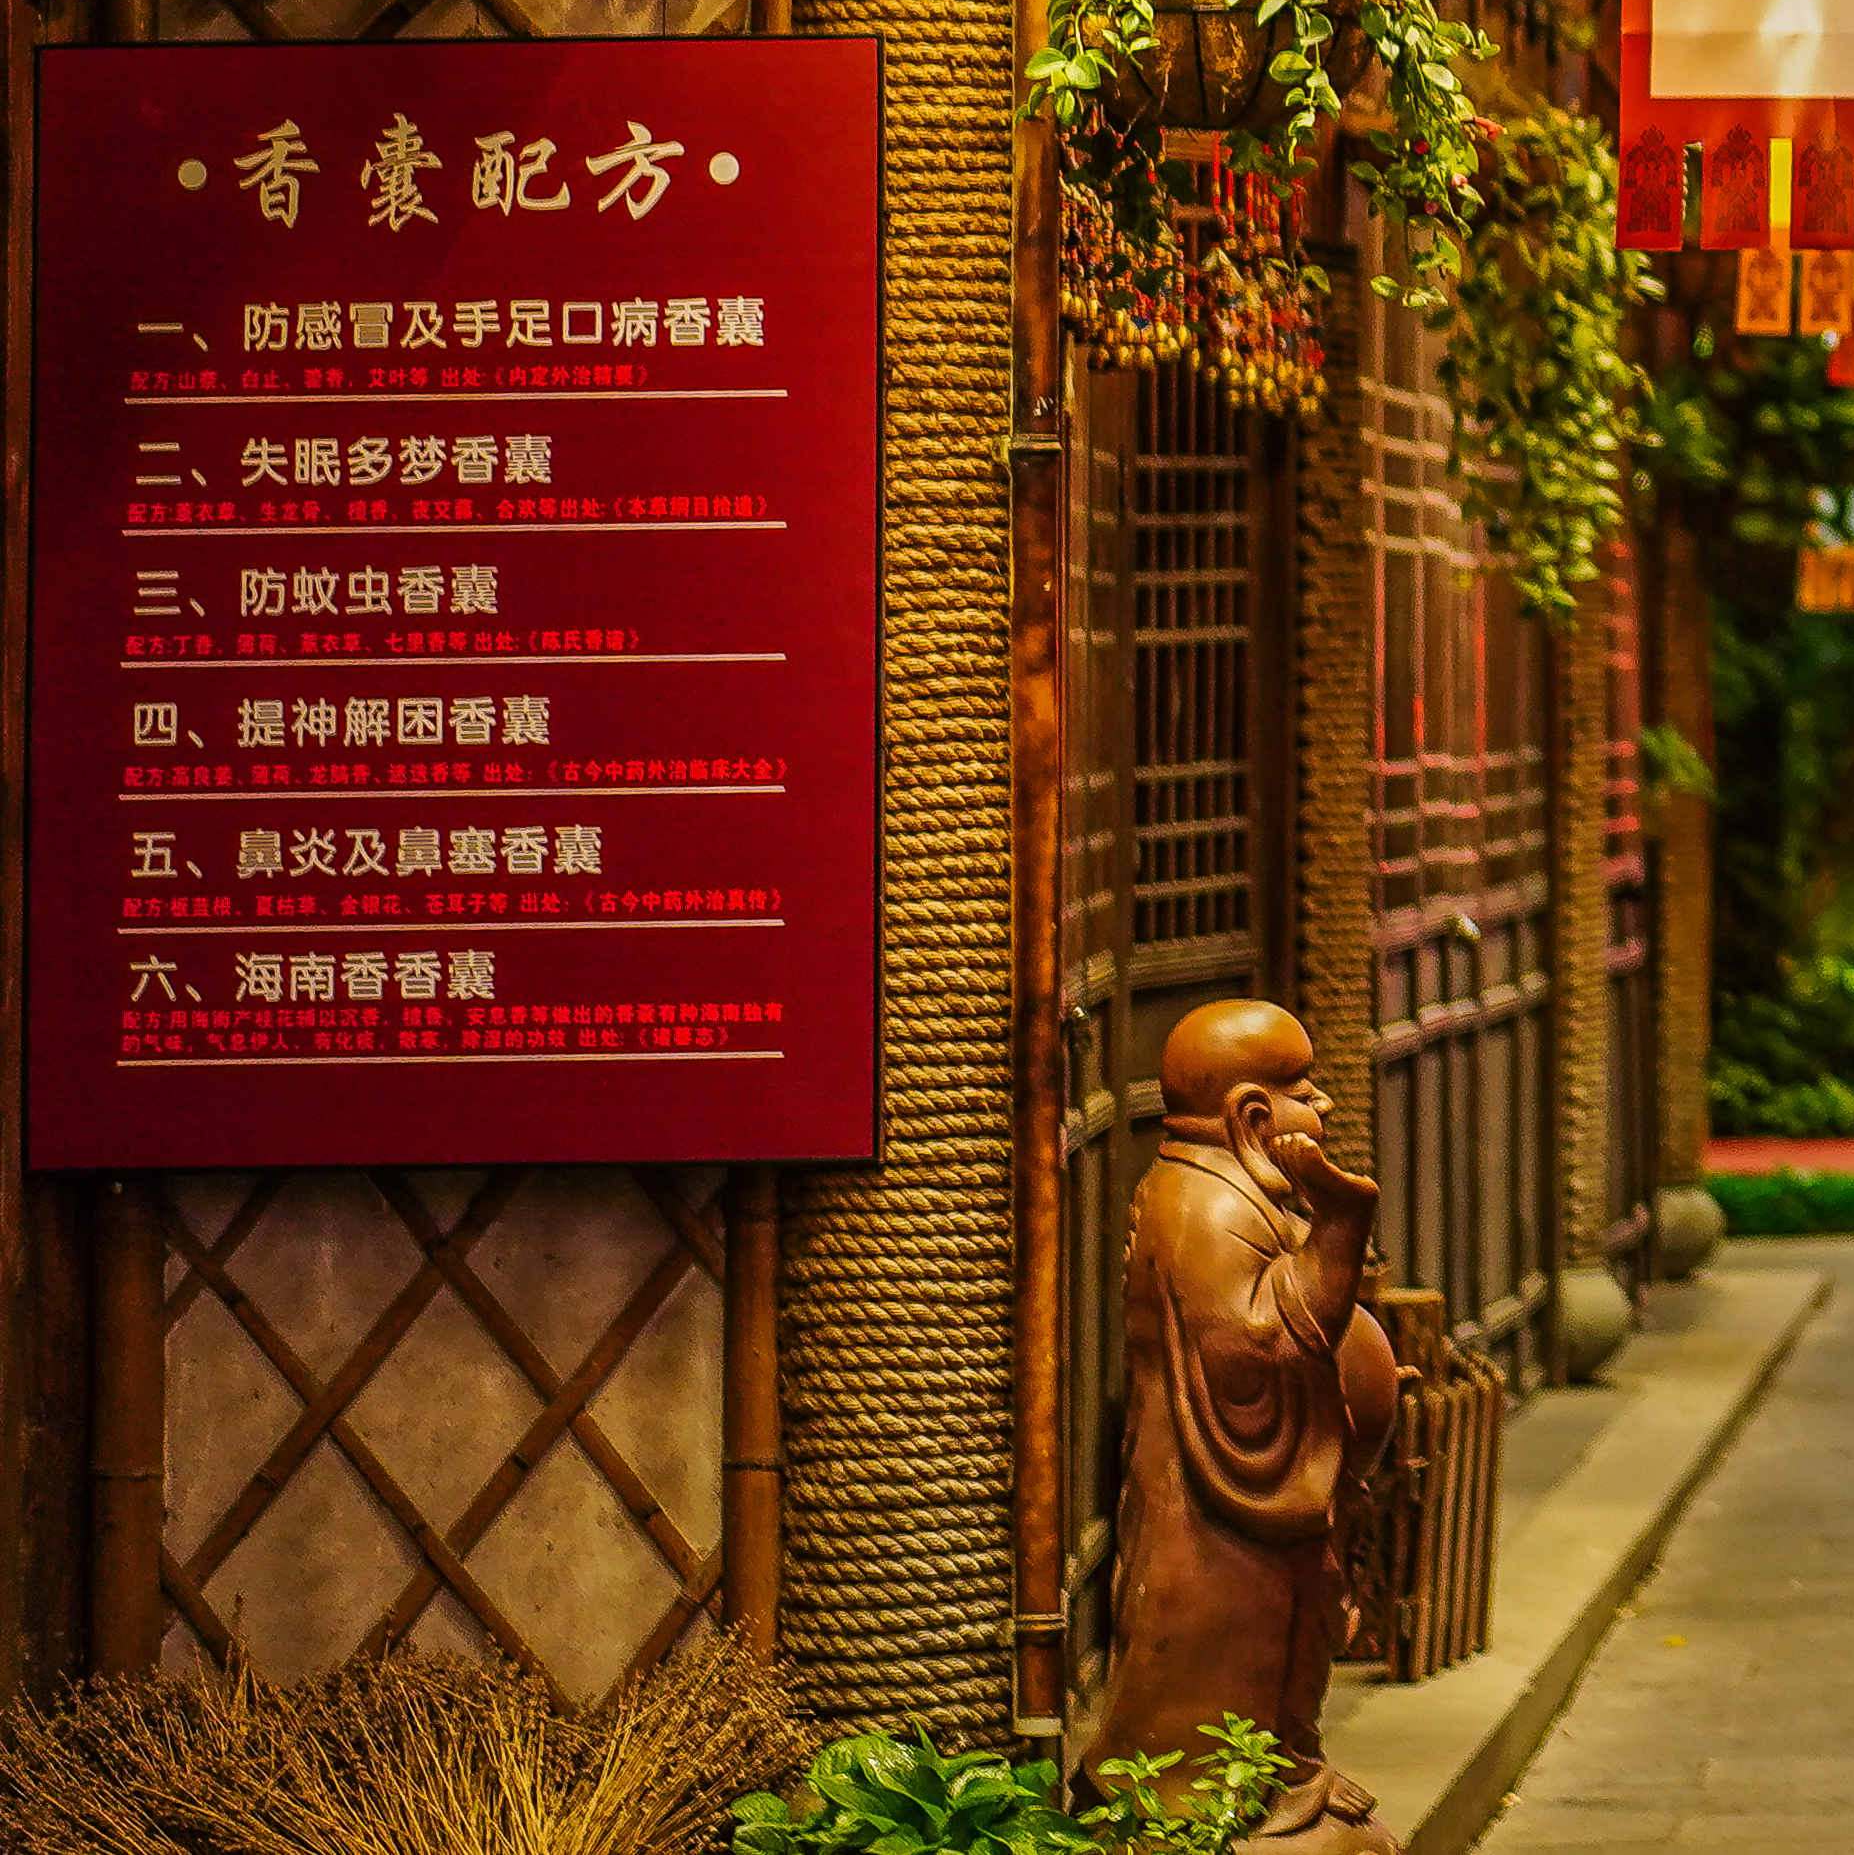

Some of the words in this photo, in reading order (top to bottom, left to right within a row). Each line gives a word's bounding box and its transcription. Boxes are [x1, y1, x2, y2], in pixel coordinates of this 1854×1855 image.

[234, 112, 685, 232] 香囊配方
[137, 295, 765, 352] 一、防感冒及手足口病香囊
[135, 433, 553, 487] 二、失眠多梦香囊
[133, 563, 498, 617] 三、防蚊虫香囊
[133, 694, 550, 748] 四、提神解困香囊
[131, 823, 603, 879] 五、鼻炎及鼻塞香囊
[129, 948, 496, 1003] 六、海南香香囊
